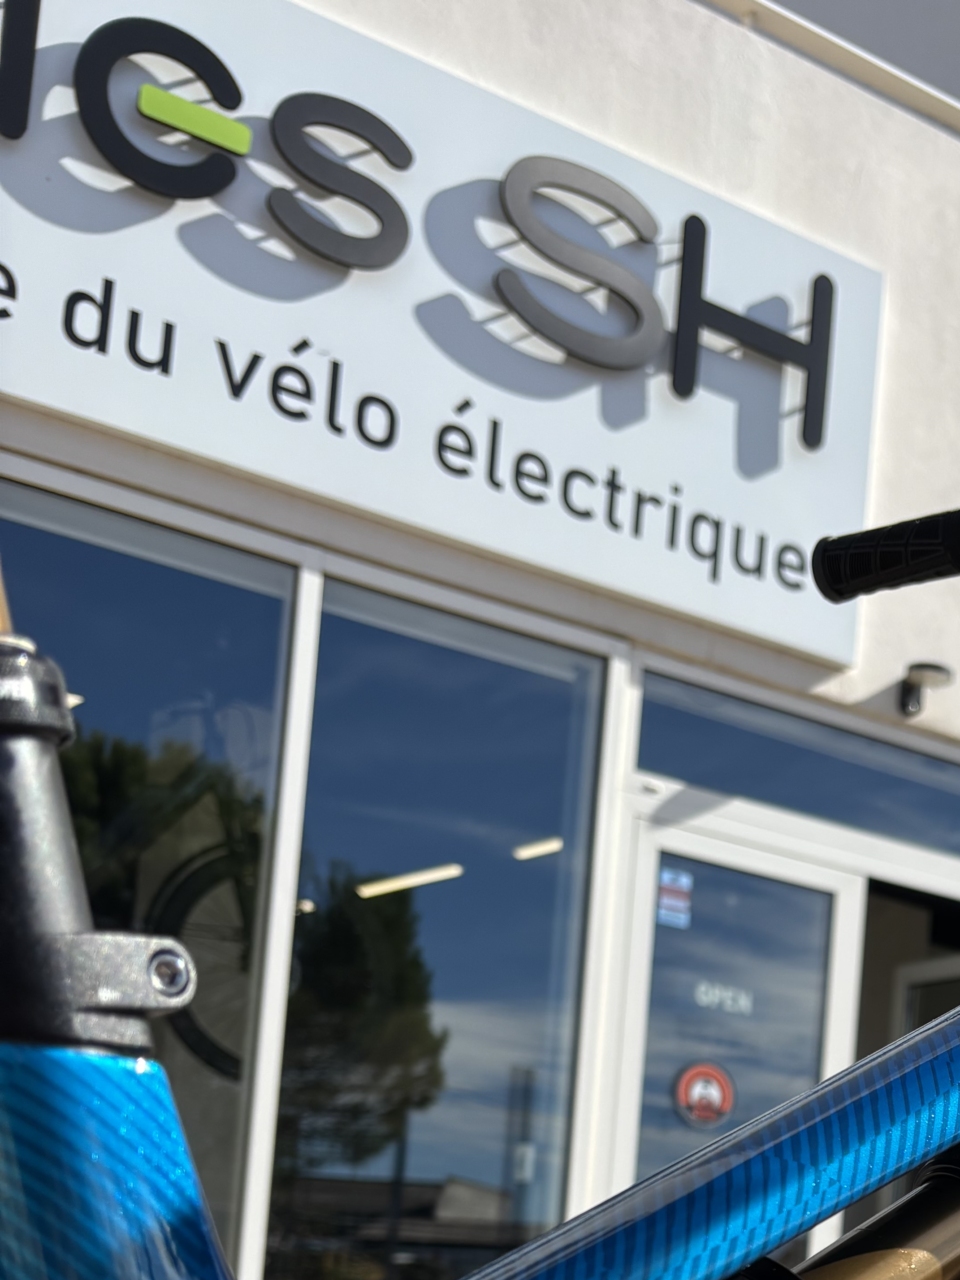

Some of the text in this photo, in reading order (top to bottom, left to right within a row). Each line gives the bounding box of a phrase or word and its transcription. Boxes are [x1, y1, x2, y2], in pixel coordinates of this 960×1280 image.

[61, 276, 176, 377] du
[214, 340, 398, 453] vélo
[436, 400, 807, 592] électrique
